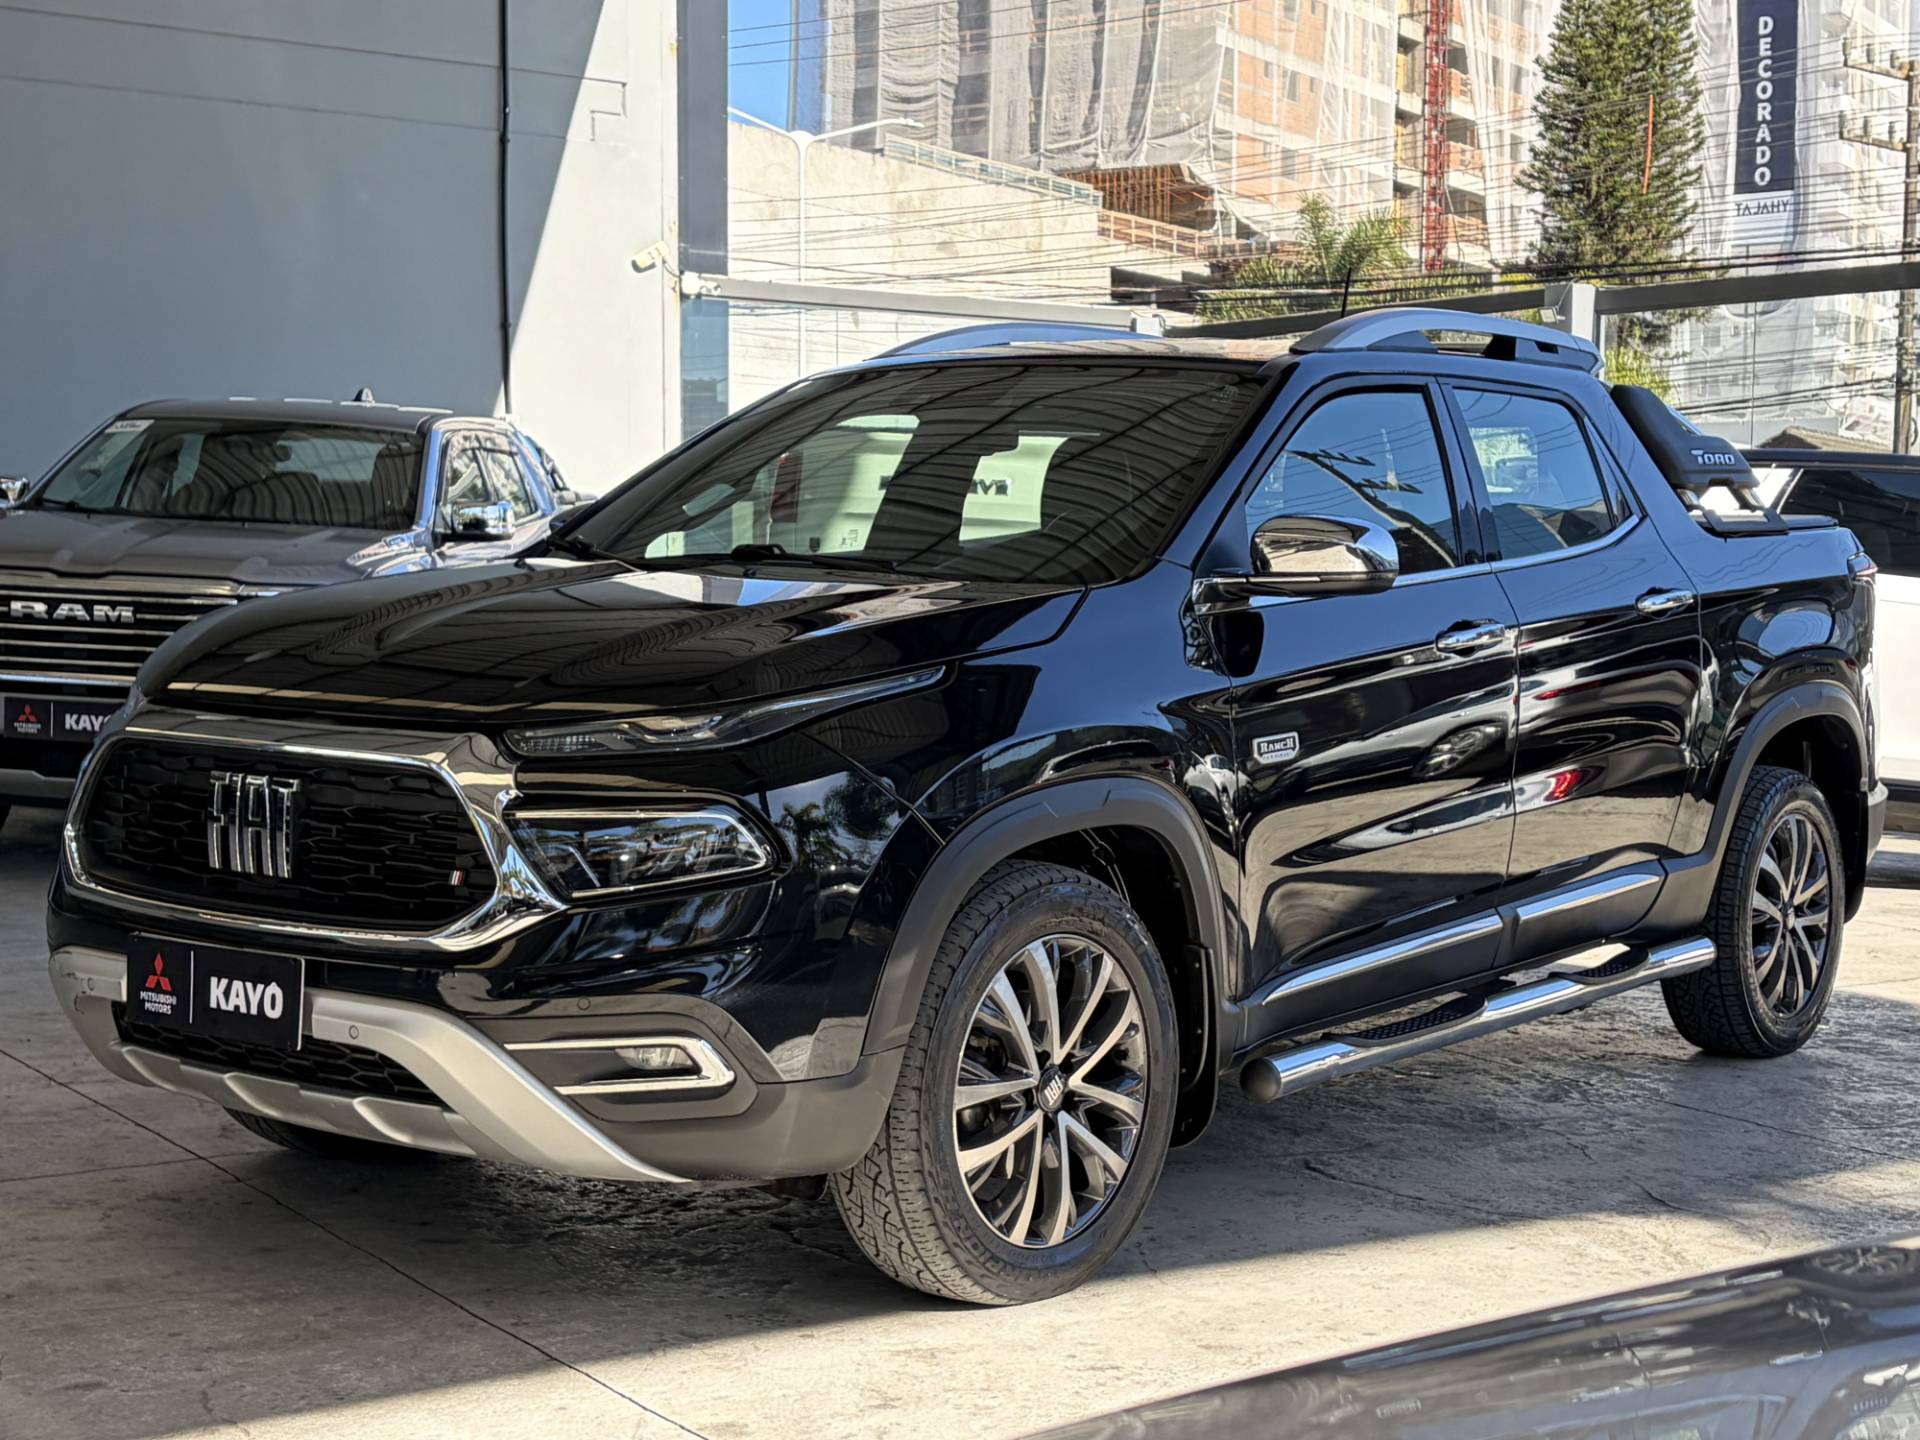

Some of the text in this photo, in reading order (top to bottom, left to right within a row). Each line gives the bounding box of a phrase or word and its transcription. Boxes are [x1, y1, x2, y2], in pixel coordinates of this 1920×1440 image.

[1754, 16, 1774, 186] DECORADO
[1690, 449, 1735, 464] TORO
[10, 600, 134, 623] RAM
[1260, 738, 1294, 752] RANCH
[207, 770, 300, 879] FIAT
[139, 991, 177, 1006] MITSUBISHI
[144, 1002, 172, 1015] MOTORS
